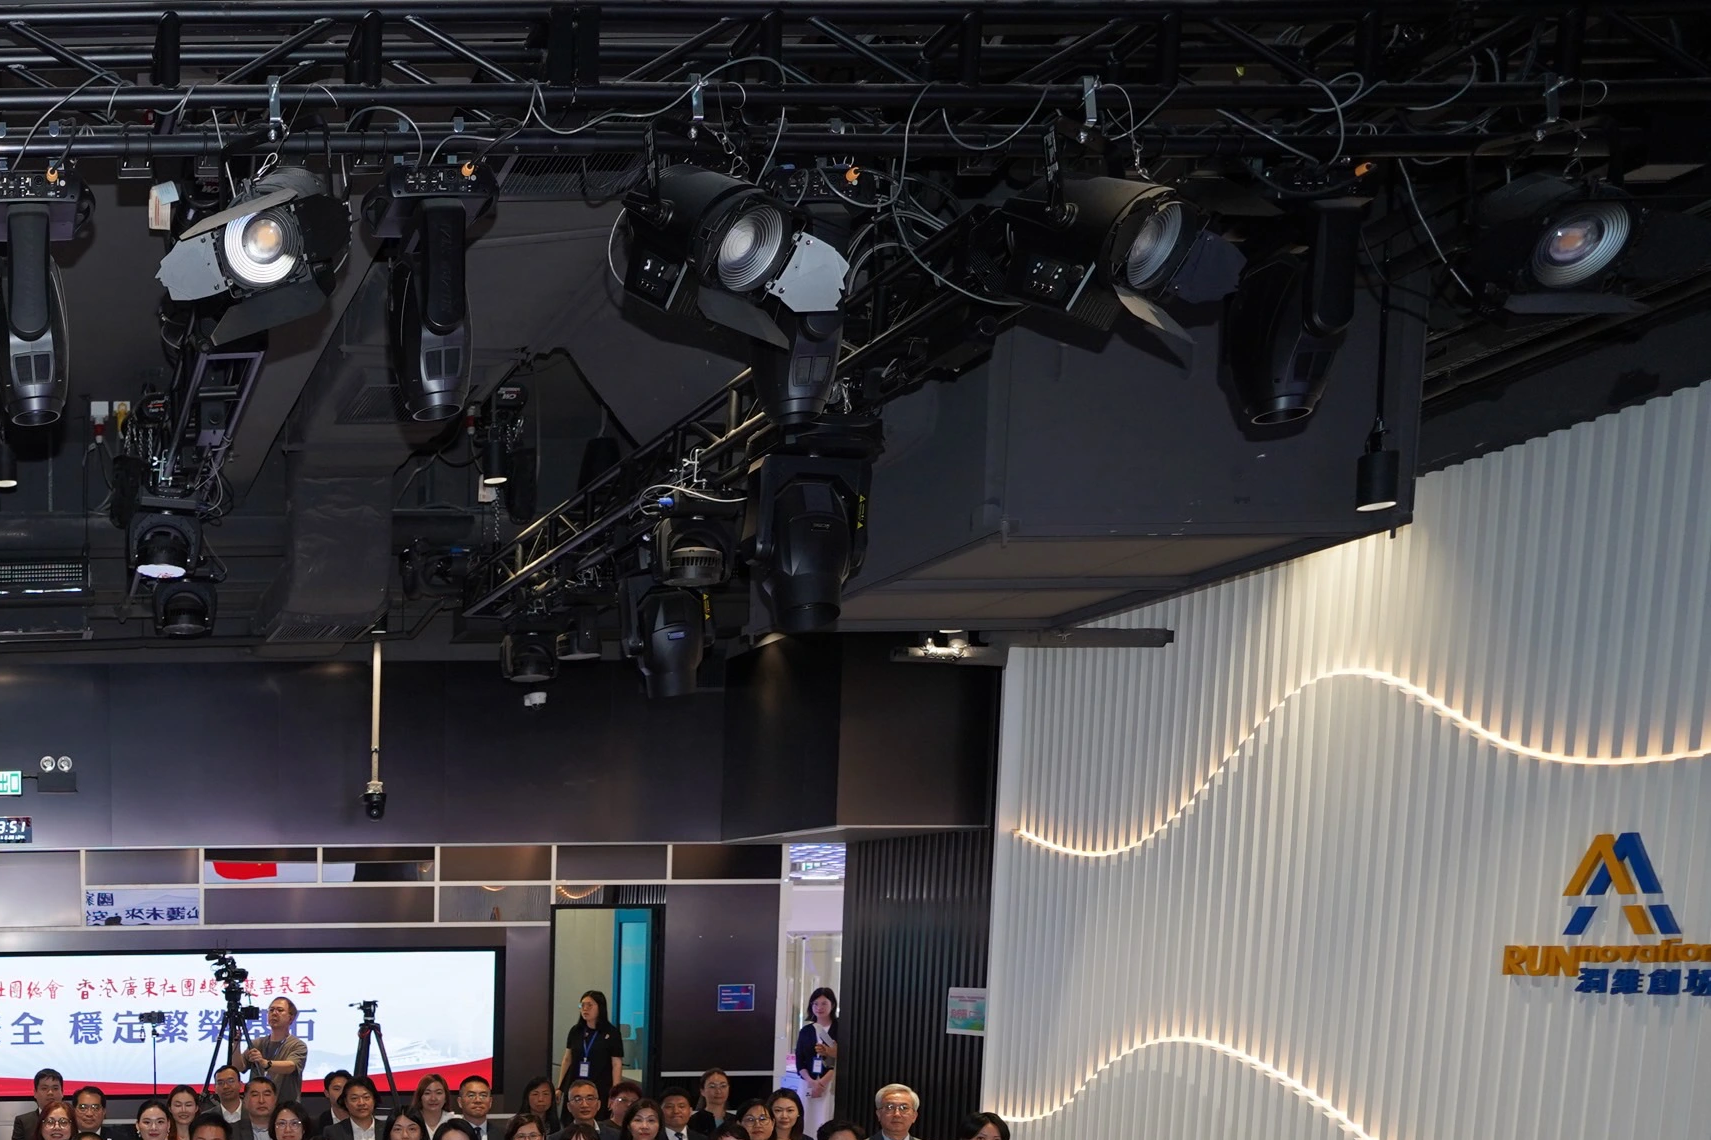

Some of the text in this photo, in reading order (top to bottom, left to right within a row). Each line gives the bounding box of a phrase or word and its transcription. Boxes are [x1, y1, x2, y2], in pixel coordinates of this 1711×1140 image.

[76, 976, 316, 1000] 香港廣東社團總慈善基金
